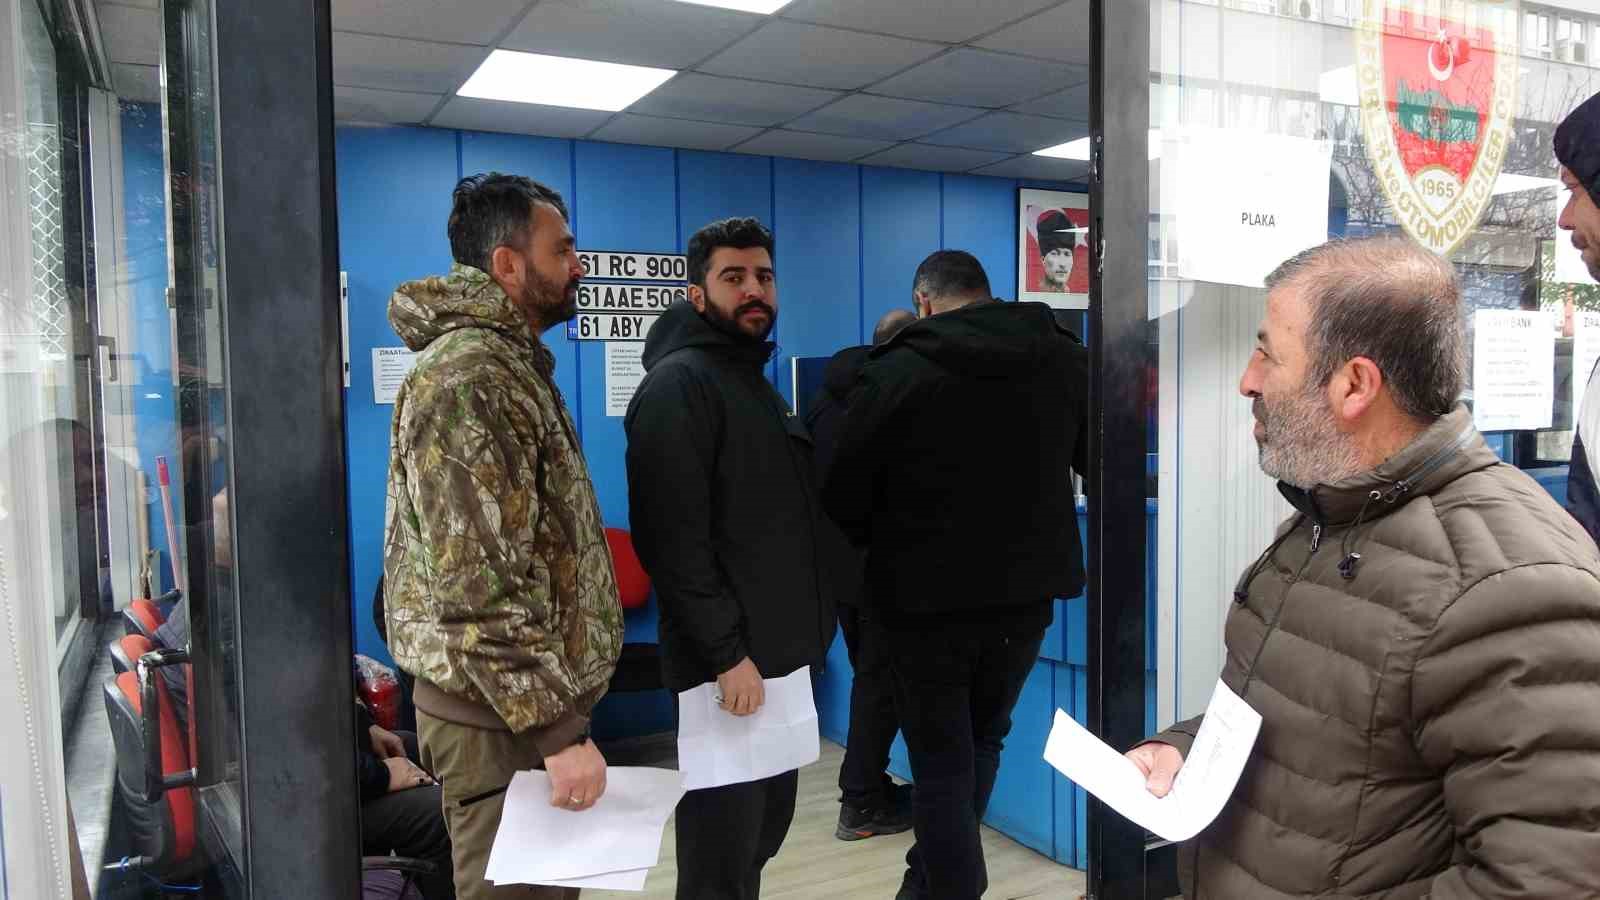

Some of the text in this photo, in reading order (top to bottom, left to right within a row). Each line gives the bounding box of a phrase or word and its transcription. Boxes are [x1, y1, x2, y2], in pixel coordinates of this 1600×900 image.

[1421, 178, 1455, 199] 1965
[1241, 211, 1276, 227] PLAKA
[578, 254, 686, 278] 61 RC 900
[580, 316, 643, 338] 61 ABY
